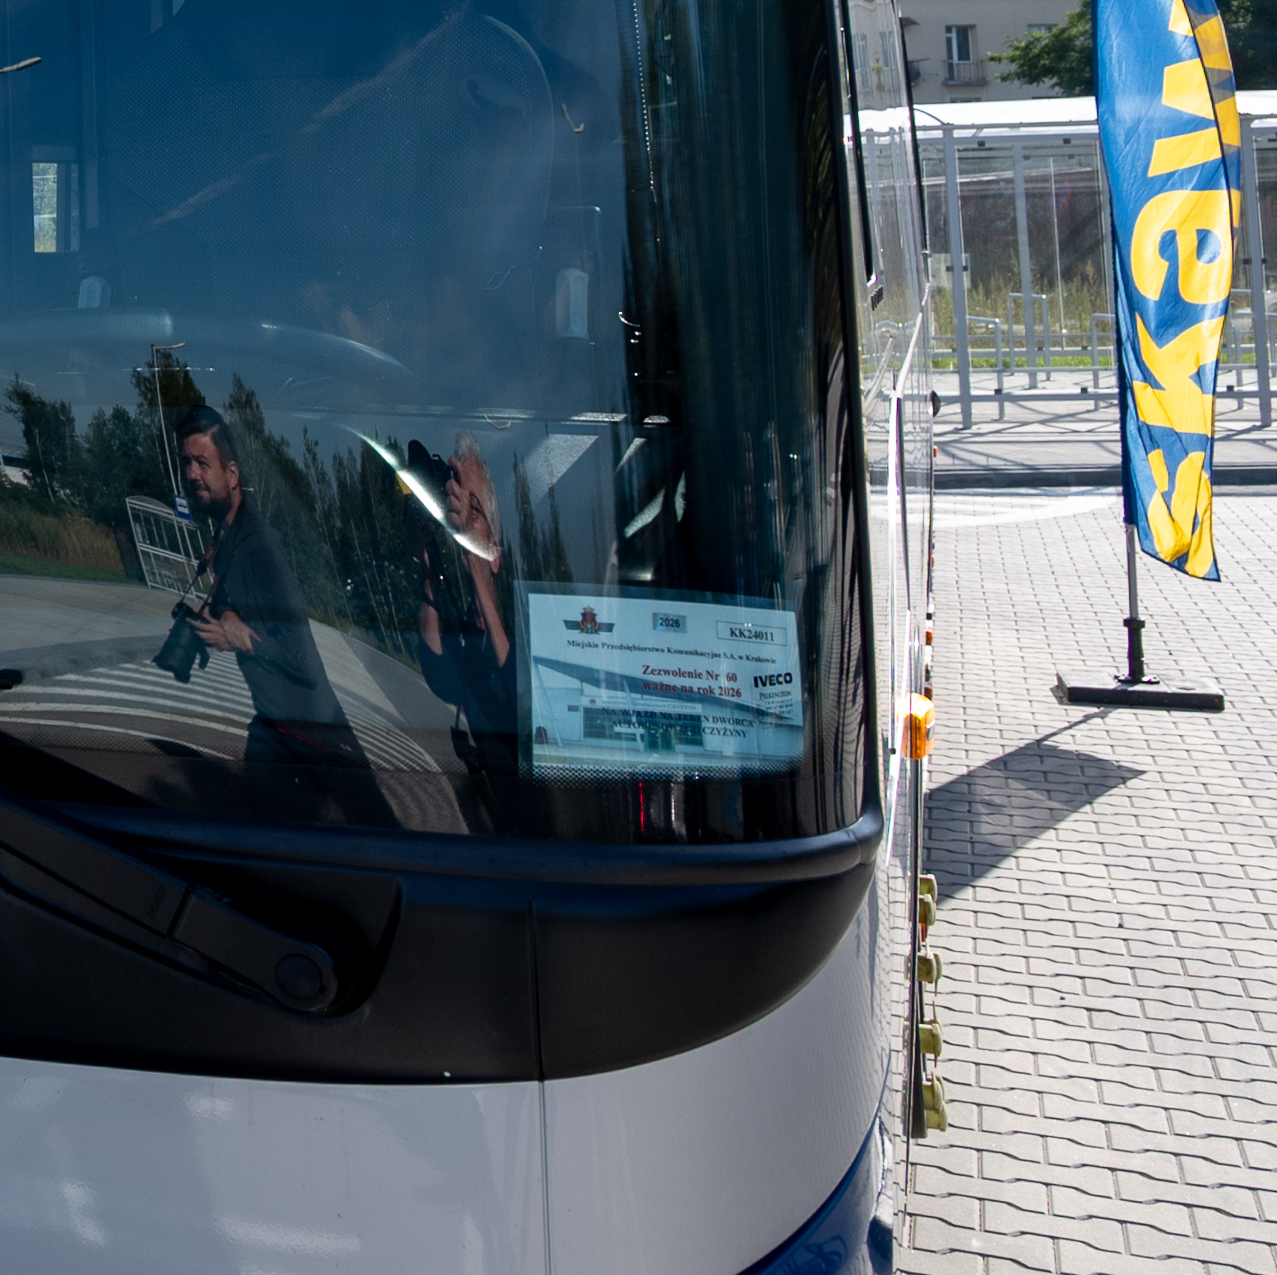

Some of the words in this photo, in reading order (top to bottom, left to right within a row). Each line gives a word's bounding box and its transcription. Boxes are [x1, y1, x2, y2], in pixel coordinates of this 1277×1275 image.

[659, 617, 681, 629] 2026
[729, 627, 775, 642] KK24011
[567, 639, 599, 650] Miejskie
[745, 654, 777, 665] Krakowie
[642, 664, 703, 681] Zezwolenie
[705, 670, 720, 682] Nr
[725, 672, 738, 683] 60
[753, 672, 793, 688] IVECO
[642, 680, 678, 693] ważne
[680, 685, 694, 694] na
[697, 685, 716, 696] rok
[718, 686, 742, 698] 2026
[712, 714, 755, 727] DWORCA
[702, 725, 748, 738] CZYŻYNY
